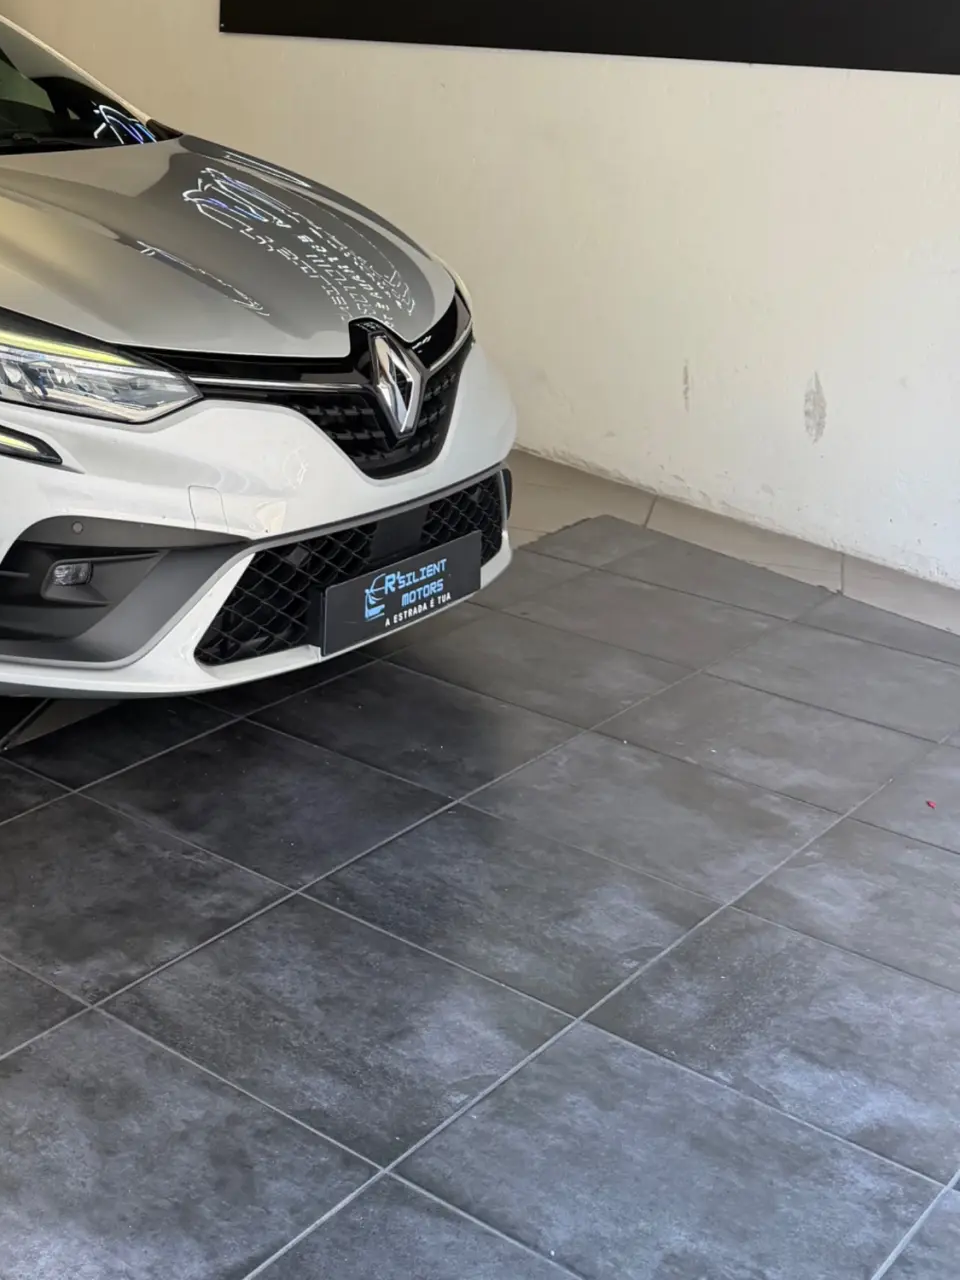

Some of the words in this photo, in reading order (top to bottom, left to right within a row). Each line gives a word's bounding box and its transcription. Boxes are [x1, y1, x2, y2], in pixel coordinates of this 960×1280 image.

[385, 558, 447, 595] R'SILIENT
[402, 578, 444, 607] MOTORS
[385, 617, 391, 627] A
[393, 602, 428, 624] ESTRADA
[437, 592, 452, 605] TUA
